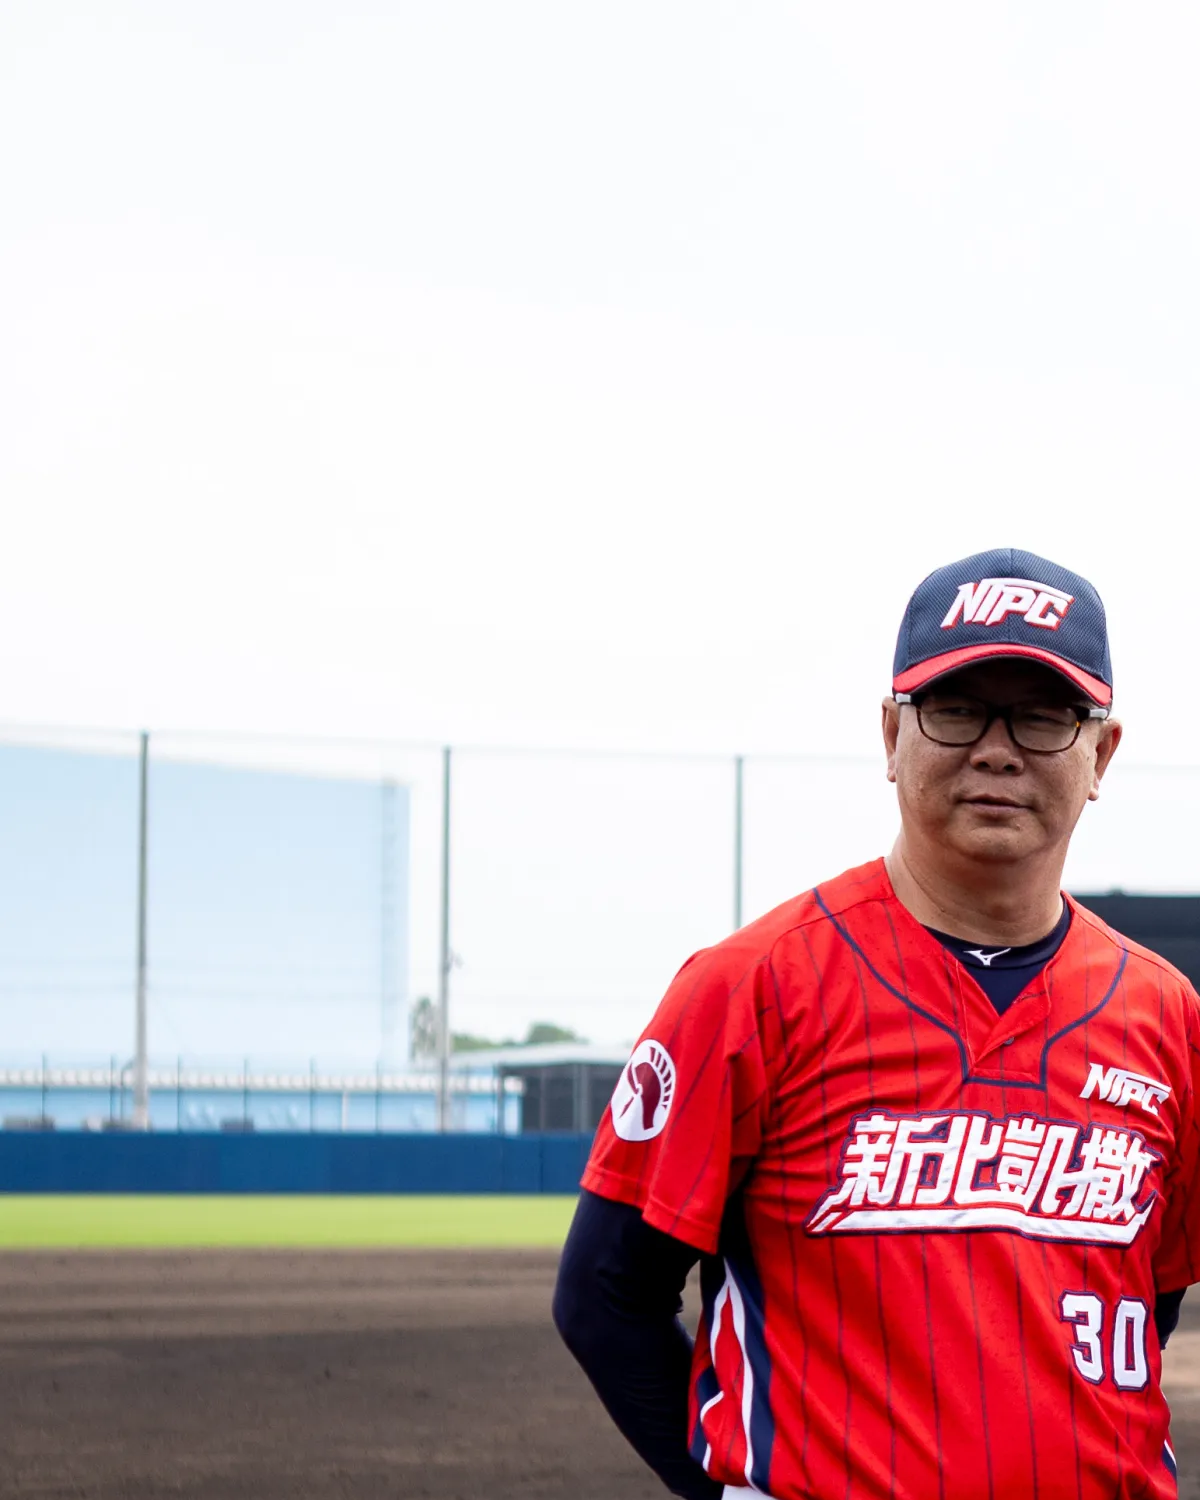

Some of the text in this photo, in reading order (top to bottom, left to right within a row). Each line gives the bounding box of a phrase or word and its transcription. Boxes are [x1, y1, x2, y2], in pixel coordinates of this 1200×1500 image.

[940, 577, 1075, 631] NTPC
[1079, 1062, 1172, 1116] NTPC
[1059, 1290, 1151, 1392] 30
